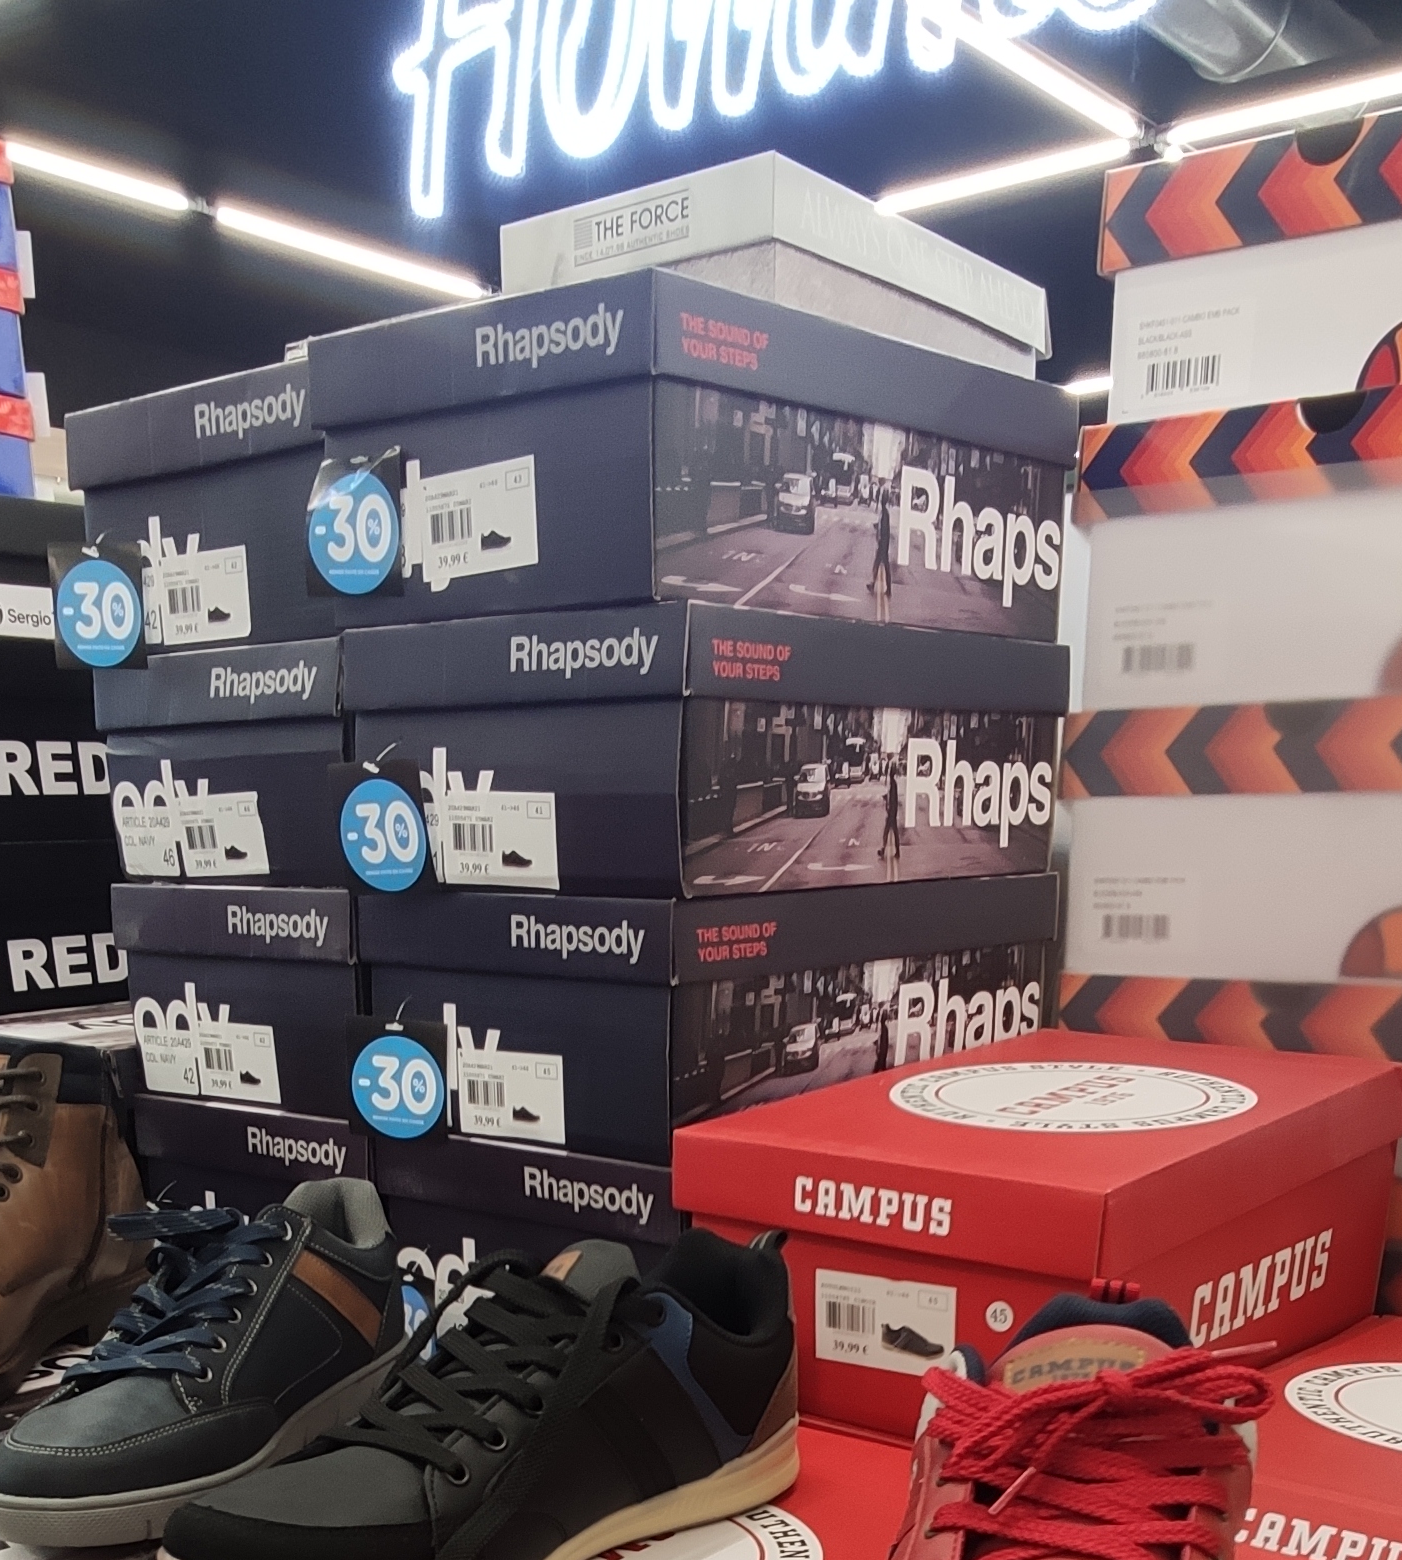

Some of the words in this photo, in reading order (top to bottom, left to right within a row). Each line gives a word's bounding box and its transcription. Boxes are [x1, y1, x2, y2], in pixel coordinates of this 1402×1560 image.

[595, 214, 624, 242] THE
[630, 197, 689, 234] FORCE
[801, 186, 880, 262] ALWAYS
[475, 303, 624, 368] Rhapsody
[680, 312, 705, 334] THE
[708, 318, 752, 345] SOUND
[753, 330, 770, 351] OF
[681, 339, 717, 365] YOUR
[720, 345, 759, 371] STEPS
[194, 383, 305, 439] Rhapsody
[897, 465, 1061, 608] Rhaps
[463, 553, 470, 565] €
[7, 607, 51, 627] Sergio
[510, 627, 658, 679] Rhapsody
[712, 638, 733, 656] THE
[735, 641, 775, 661] SOUND
[776, 645, 791, 662] OF
[712, 661, 744, 679] YOUR
[745, 664, 780, 682] STEPS
[209, 660, 317, 704] Rhapsody
[904, 738, 1052, 848] Rhaps
[163, 848, 176, 868] 46
[460, 862, 482, 876] 39,99
[484, 862, 490, 875] €
[227, 905, 328, 947] Rhapsody
[510, 914, 645, 964] Rhapsody
[696, 927, 719, 943] THE
[721, 925, 760, 941] SOUND
[761, 922, 777, 937] OF
[6, 932, 129, 993] RED
[698, 945, 730, 963] YOUR
[731, 942, 768, 959] STEPS
[894, 976, 1041, 1068] Rhaps
[183, 1066, 196, 1085] 42
[995, 1074, 1139, 1117] CAMPUS
[473, 1114, 497, 1128] 39,99
[497, 1115, 503, 1128] €
[247, 1125, 346, 1174] Rhapsody
[523, 1165, 655, 1225] Rhapsody
[793, 1175, 952, 1238] CAMPUS
[1191, 1228, 1334, 1348] CAMPUS
[989, 1306, 1008, 1325] 45
[831, 1340, 860, 1355] 39,99
[862, 1343, 870, 1356] €
